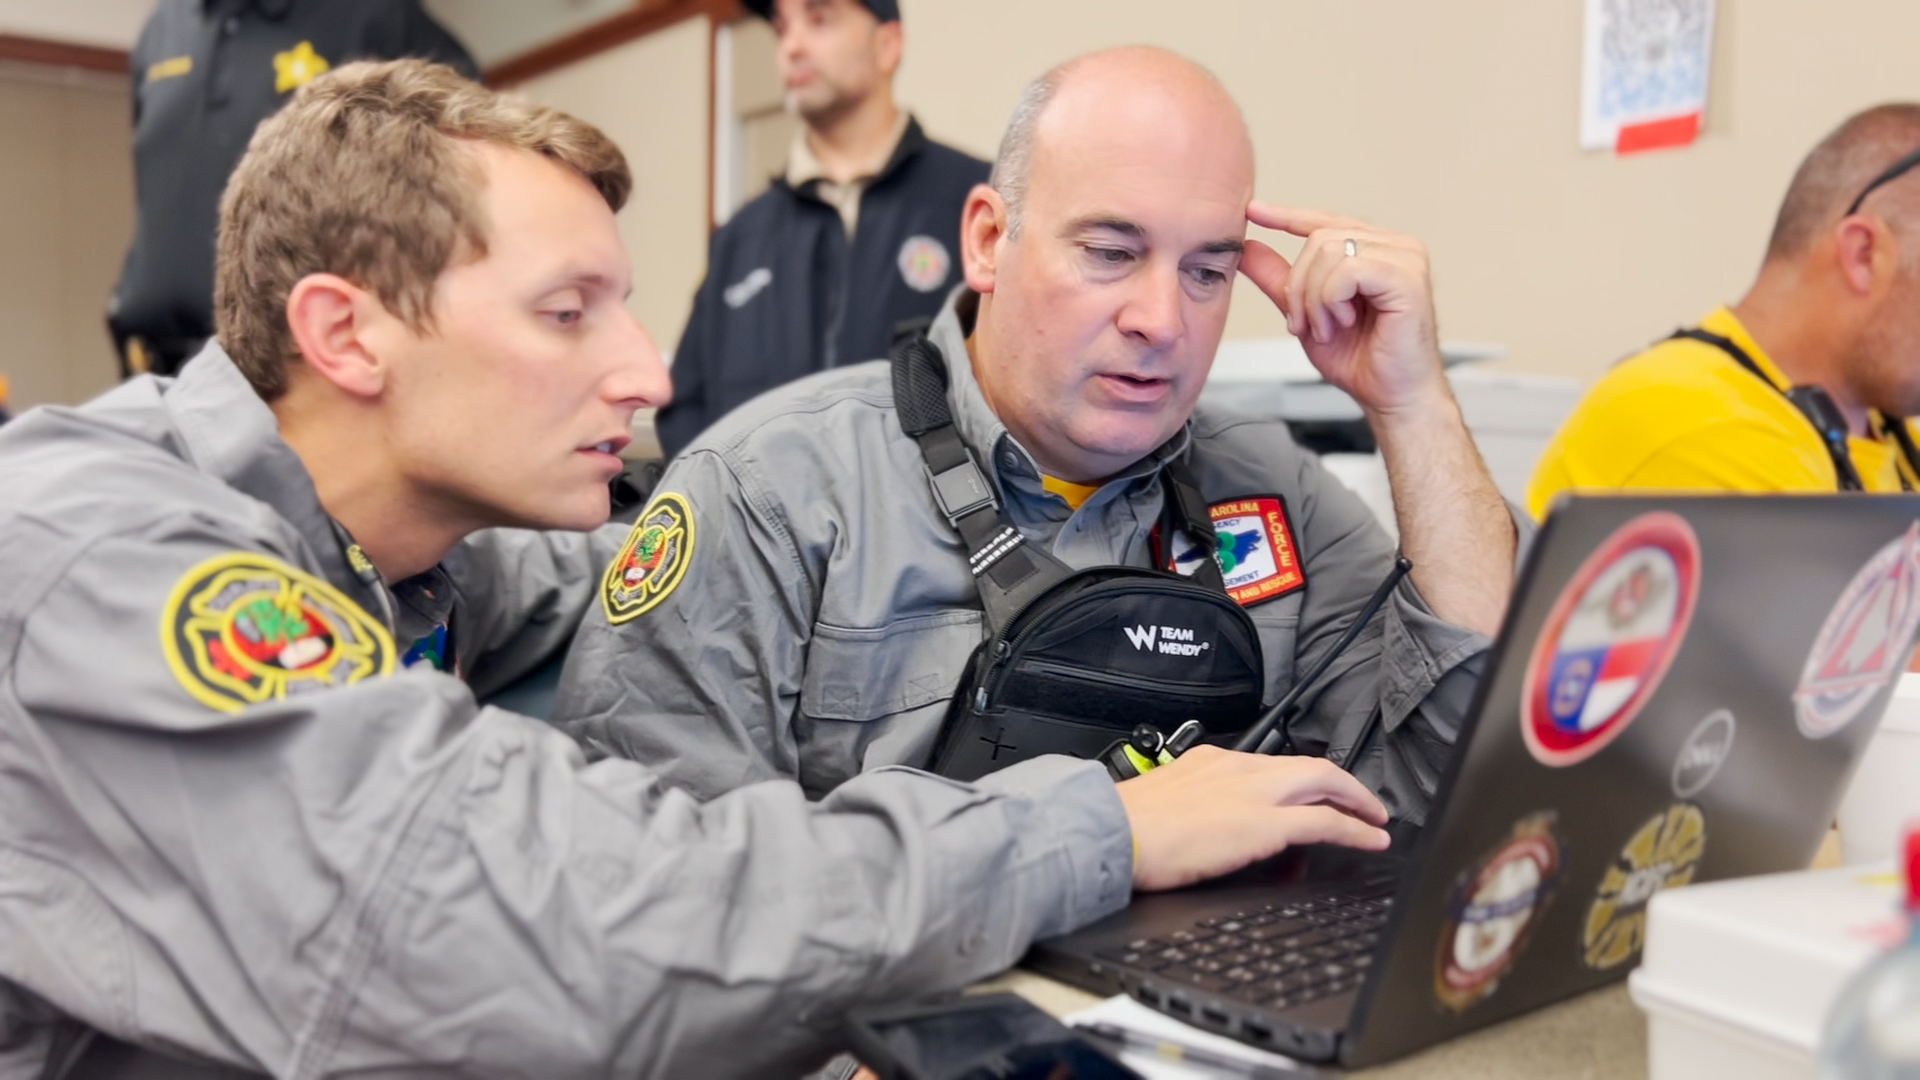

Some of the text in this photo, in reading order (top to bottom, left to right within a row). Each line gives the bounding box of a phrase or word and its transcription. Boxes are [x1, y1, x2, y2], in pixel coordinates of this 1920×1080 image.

[1210, 501, 1260, 518] AROLINA
[1216, 518, 1241, 528] ENCY
[1267, 511, 1293, 567] FORCE
[1240, 586, 1261, 599] AND
[1259, 571, 1297, 593] RESCUE
[1160, 626, 1194, 642] TEAM
